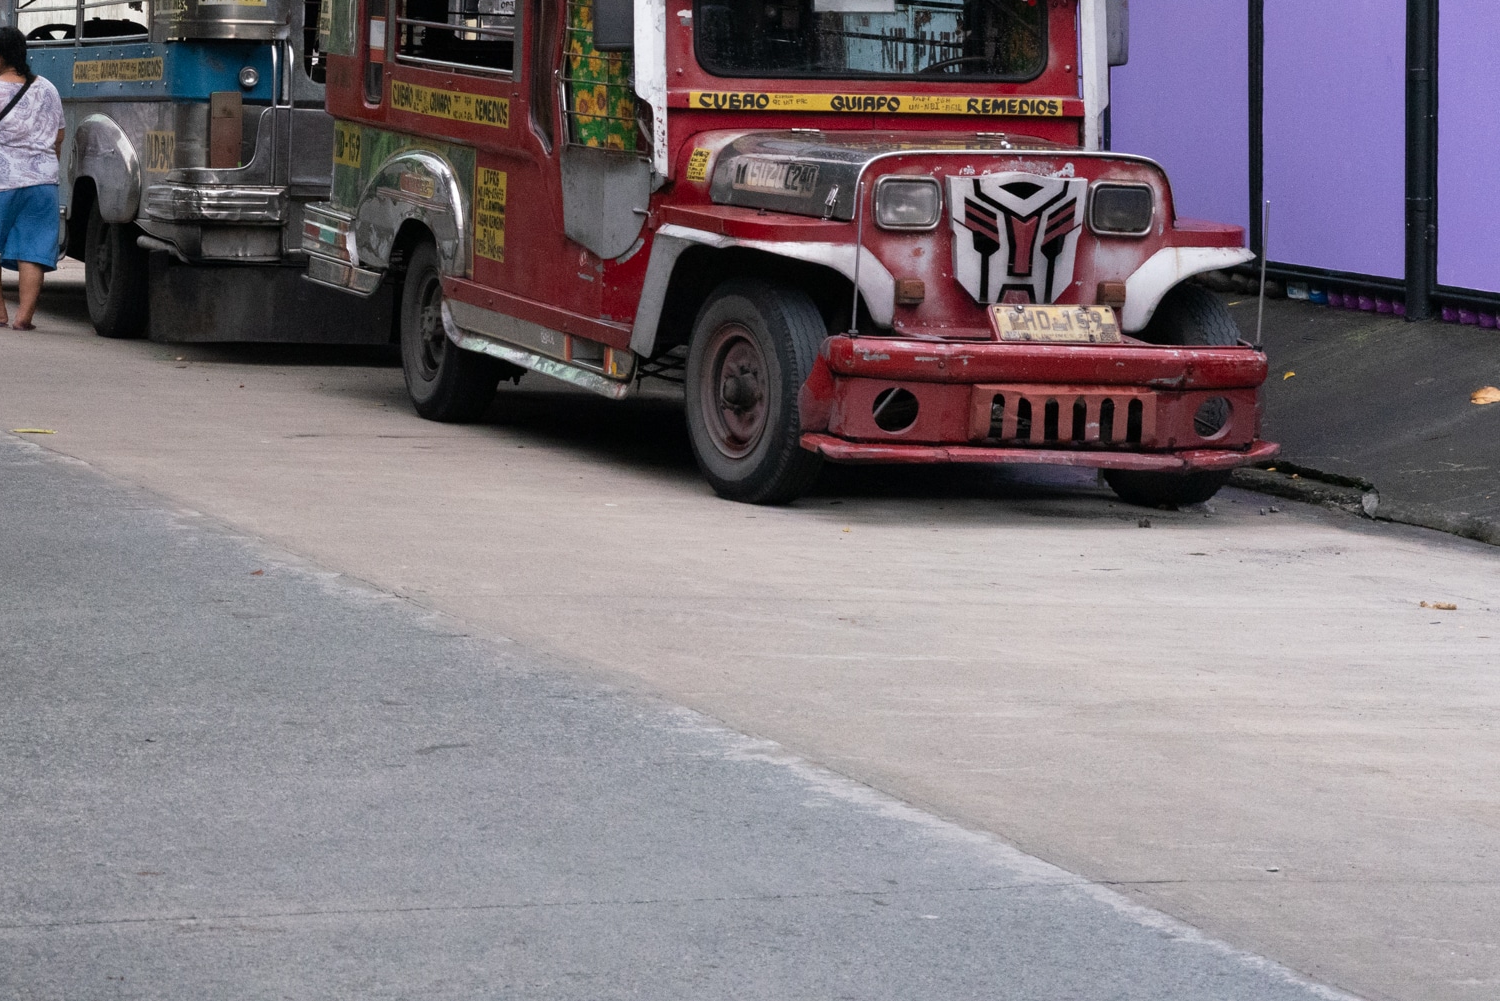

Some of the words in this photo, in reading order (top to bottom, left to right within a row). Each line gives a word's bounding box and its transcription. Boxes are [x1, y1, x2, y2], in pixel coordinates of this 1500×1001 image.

[699, 93, 770, 110] CUBAO
[830, 95, 901, 112] QUIAPO
[966, 98, 1059, 115] REMEDIOS
